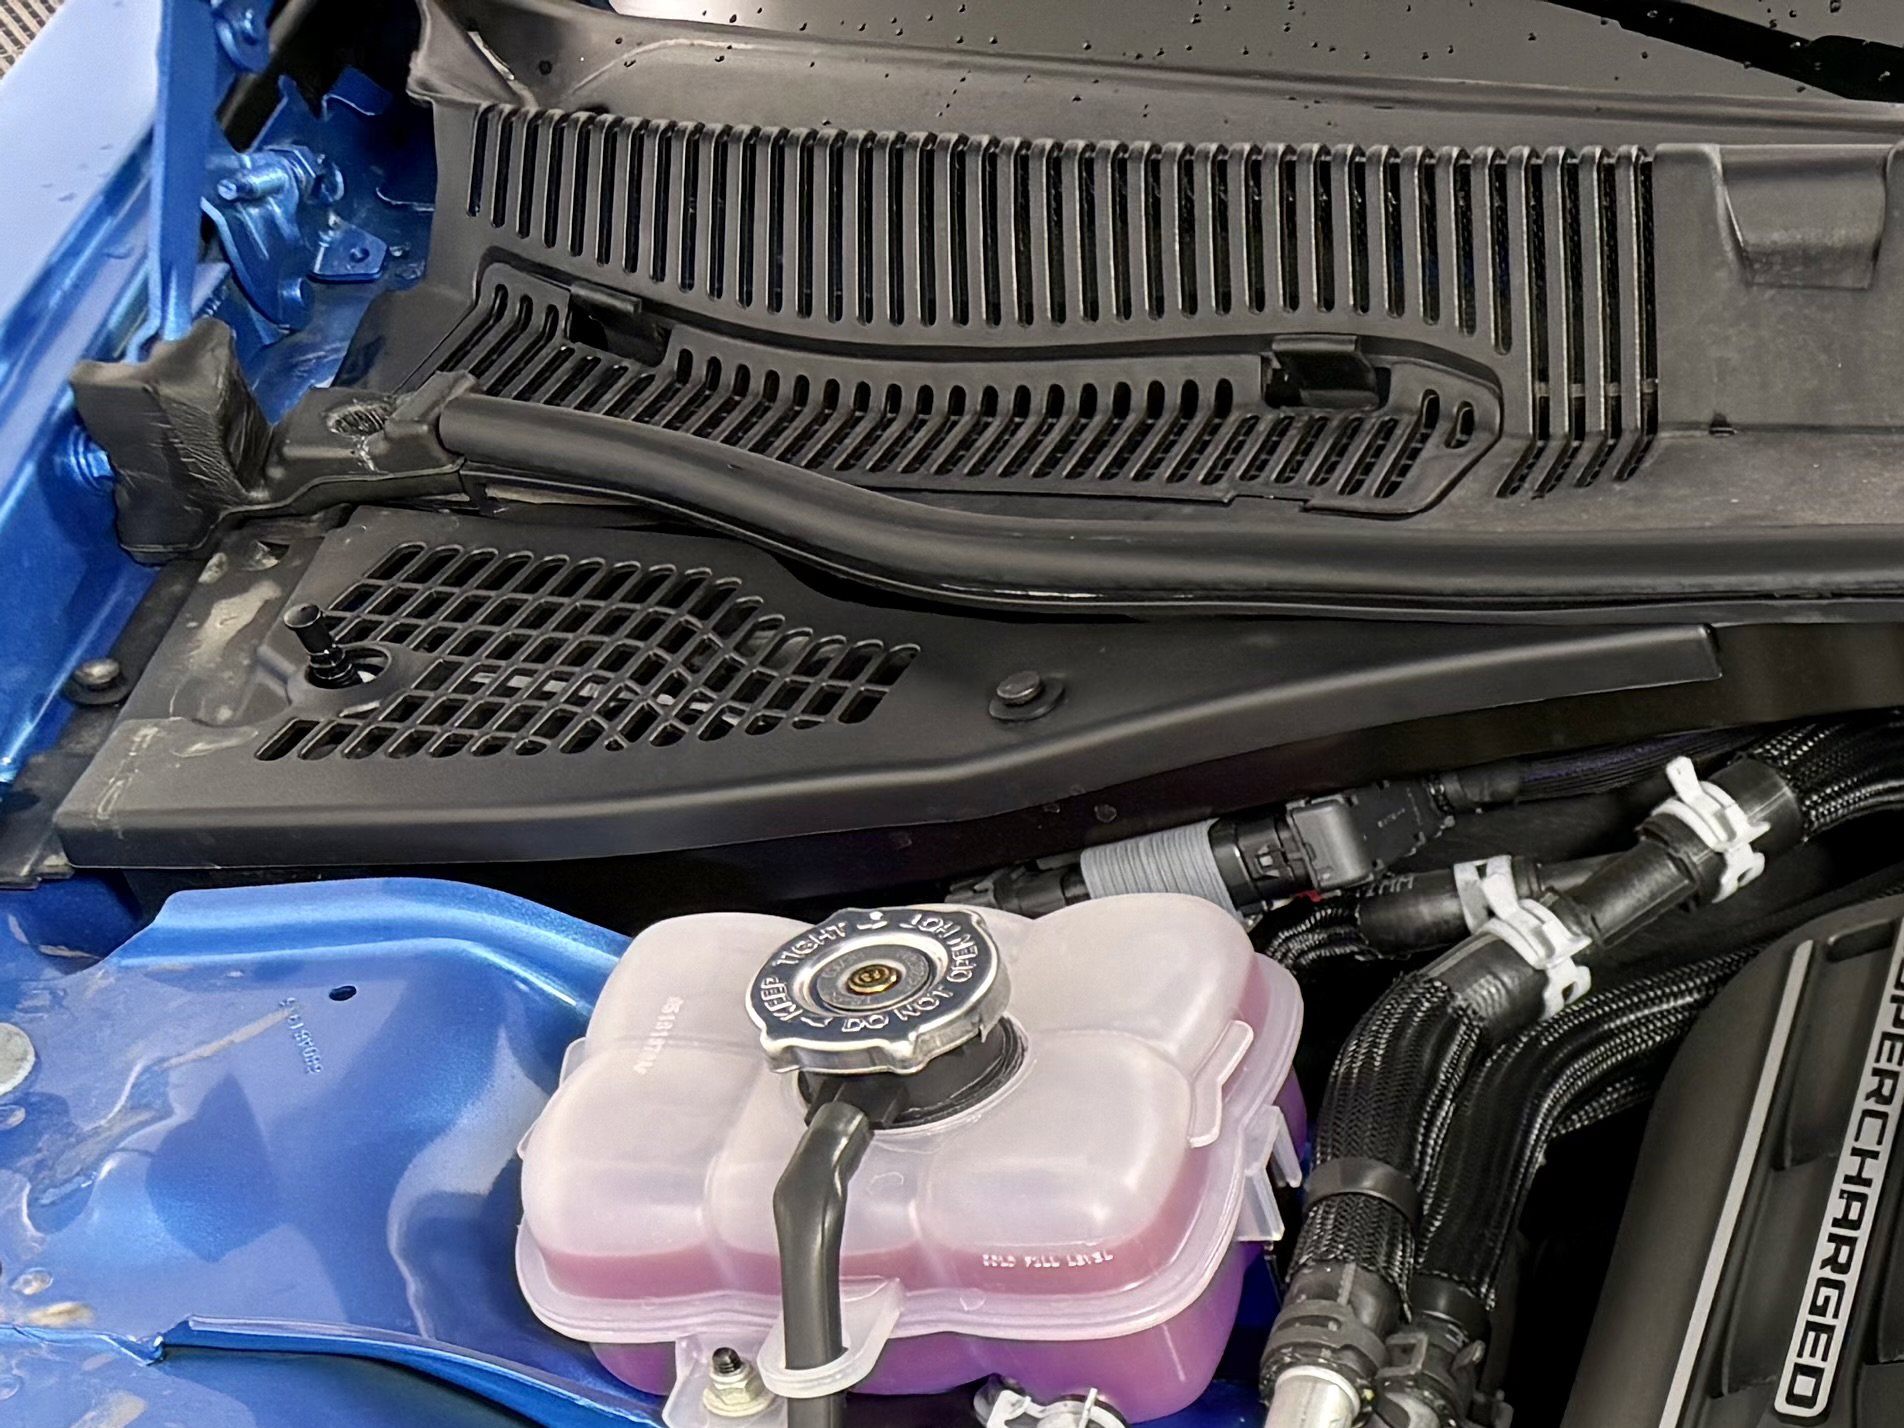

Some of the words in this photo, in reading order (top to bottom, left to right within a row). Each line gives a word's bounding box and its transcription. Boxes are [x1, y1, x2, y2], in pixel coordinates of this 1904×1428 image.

[772, 921, 848, 965] TIGHT
[761, 976, 801, 1021] KEEP
[841, 1015, 890, 1033] DO
[893, 983, 953, 1022] NOT
[946, 934, 978, 983] OPEN
